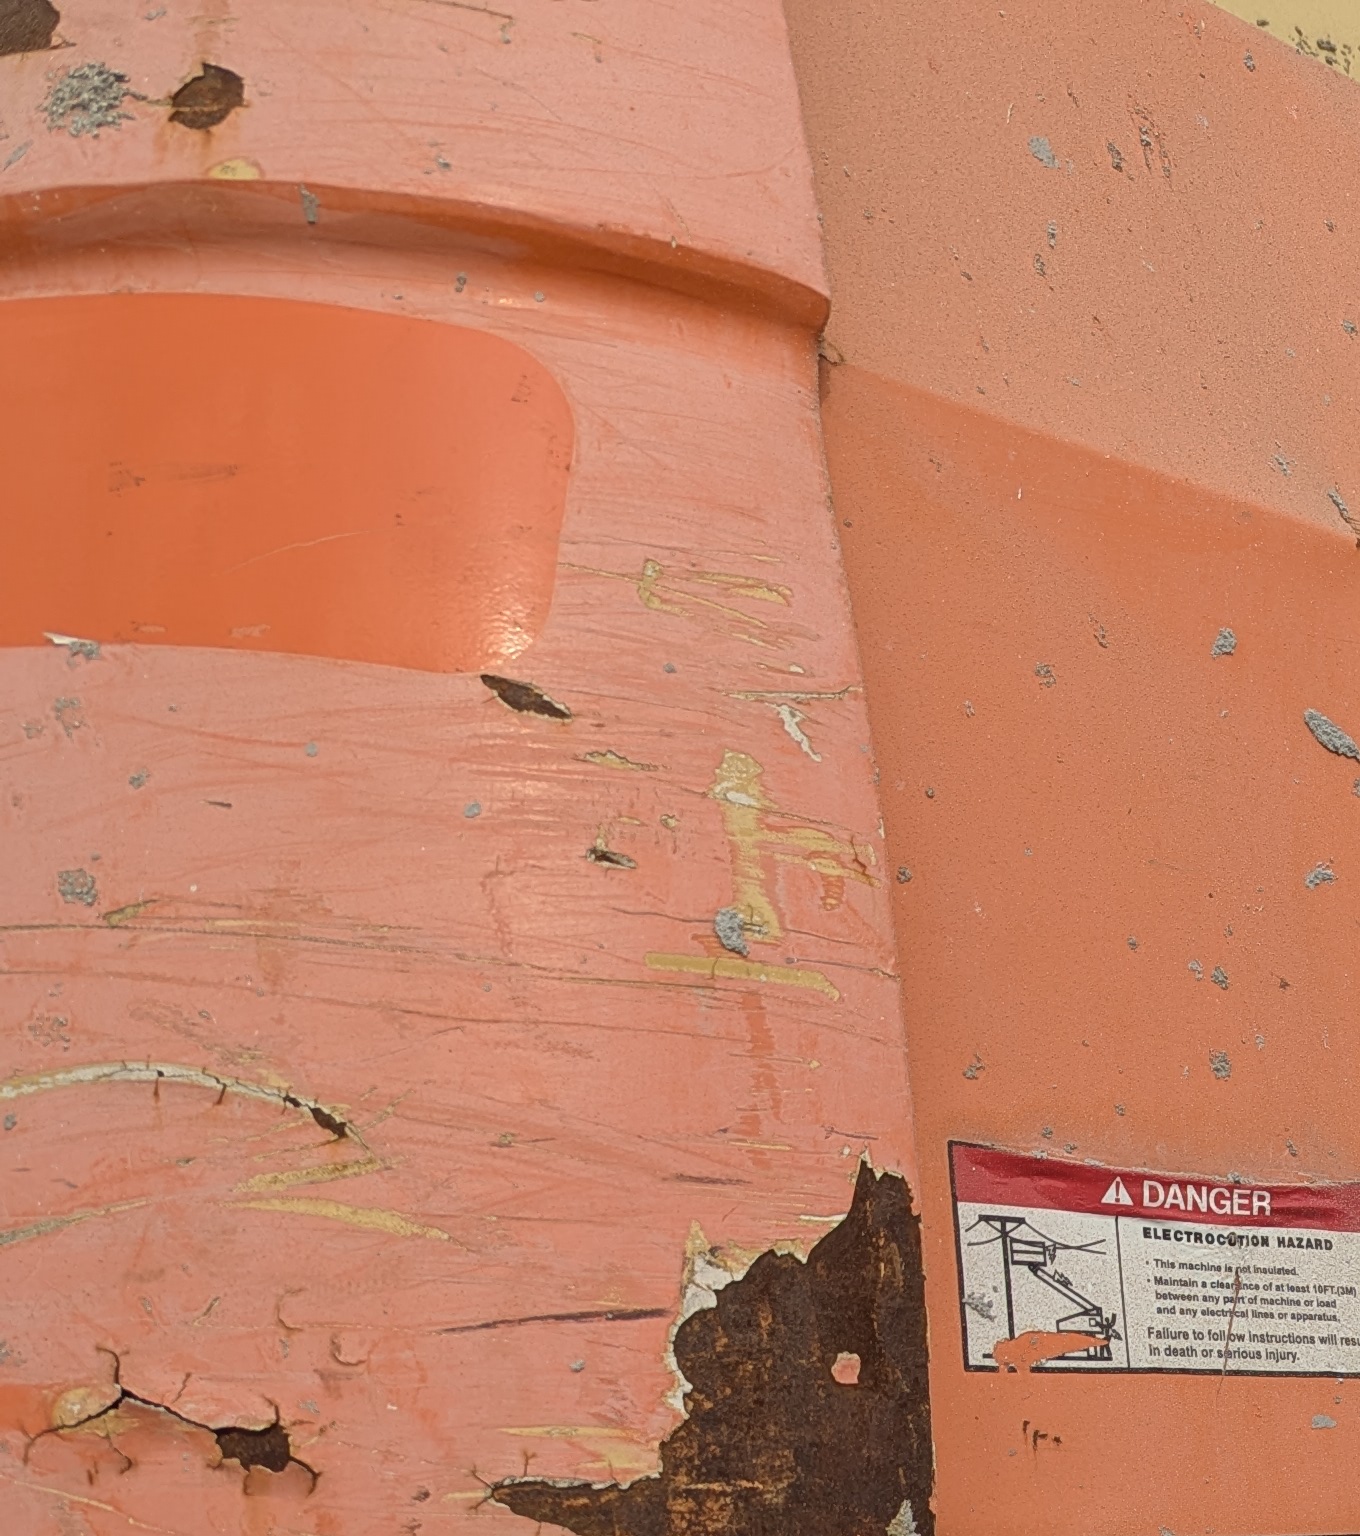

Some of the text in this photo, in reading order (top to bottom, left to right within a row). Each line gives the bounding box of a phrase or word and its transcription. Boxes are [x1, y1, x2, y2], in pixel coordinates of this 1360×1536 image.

[1143, 1180, 1271, 1216] DANGER
[1143, 1227, 1333, 1251] ELECTROCUTION HAZARD
[1153, 1259, 1299, 1276] This machine is not insulated.
[1154, 1276, 1198, 1288] Maintain
[1201, 1280, 1207, 1289] a
[1263, 1282, 1272, 1291] of
[1275, 1284, 1285, 1293] at
[1287, 1283, 1310, 1293] least
[1313, 1284, 1357, 1298] 10FT.(3M)
[1155, 1291, 1337, 1308] between any part of machine or load
[1156, 1305, 1340, 1322] and any electrical lines or apparatus.
[1147, 1327, 1189, 1340] Failure
[1192, 1329, 1205, 1341] to
[1208, 1329, 1245, 1342] follow
[1249, 1330, 1316, 1345] instructions
[1319, 1334, 1337, 1345] will
[1149, 1344, 1300, 1363] in death or serious injury.
